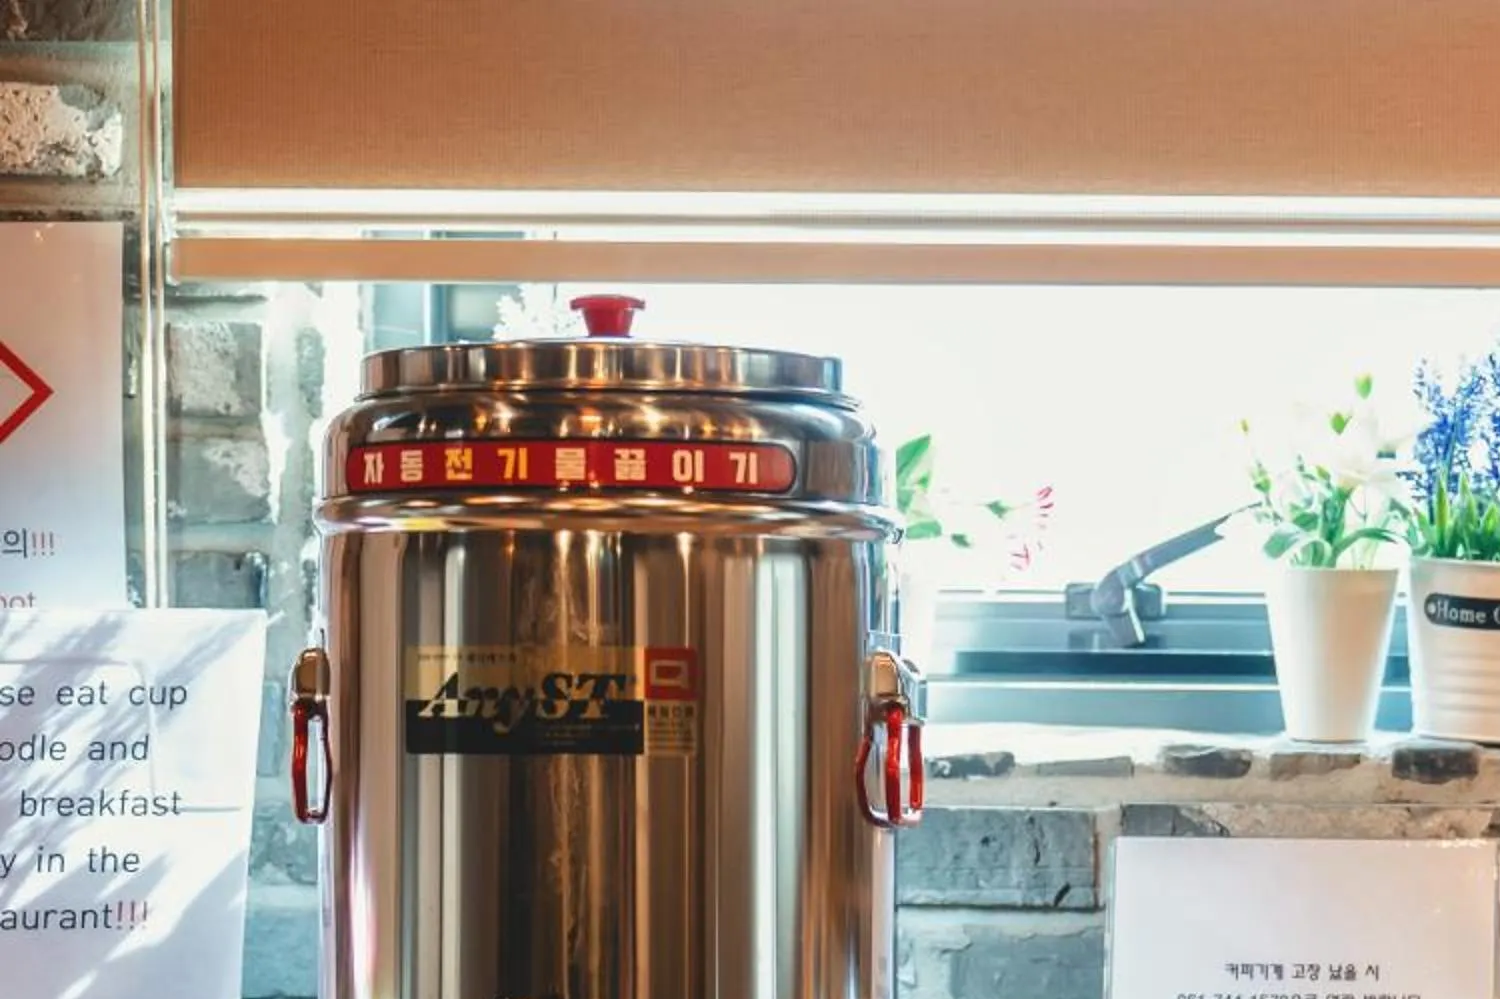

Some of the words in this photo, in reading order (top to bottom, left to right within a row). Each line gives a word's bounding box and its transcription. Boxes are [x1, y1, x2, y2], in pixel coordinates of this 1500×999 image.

[1436, 599, 1487, 624] Home
[56, 680, 108, 706] eat
[128, 684, 188, 711] cup
[87, 733, 150, 761] and
[19, 788, 182, 817] breakfast
[36, 845, 65, 873] in
[88, 846, 140, 873] the
[1291, 963, 1322, 982] 고장
[1365, 963, 1381, 982] 시
